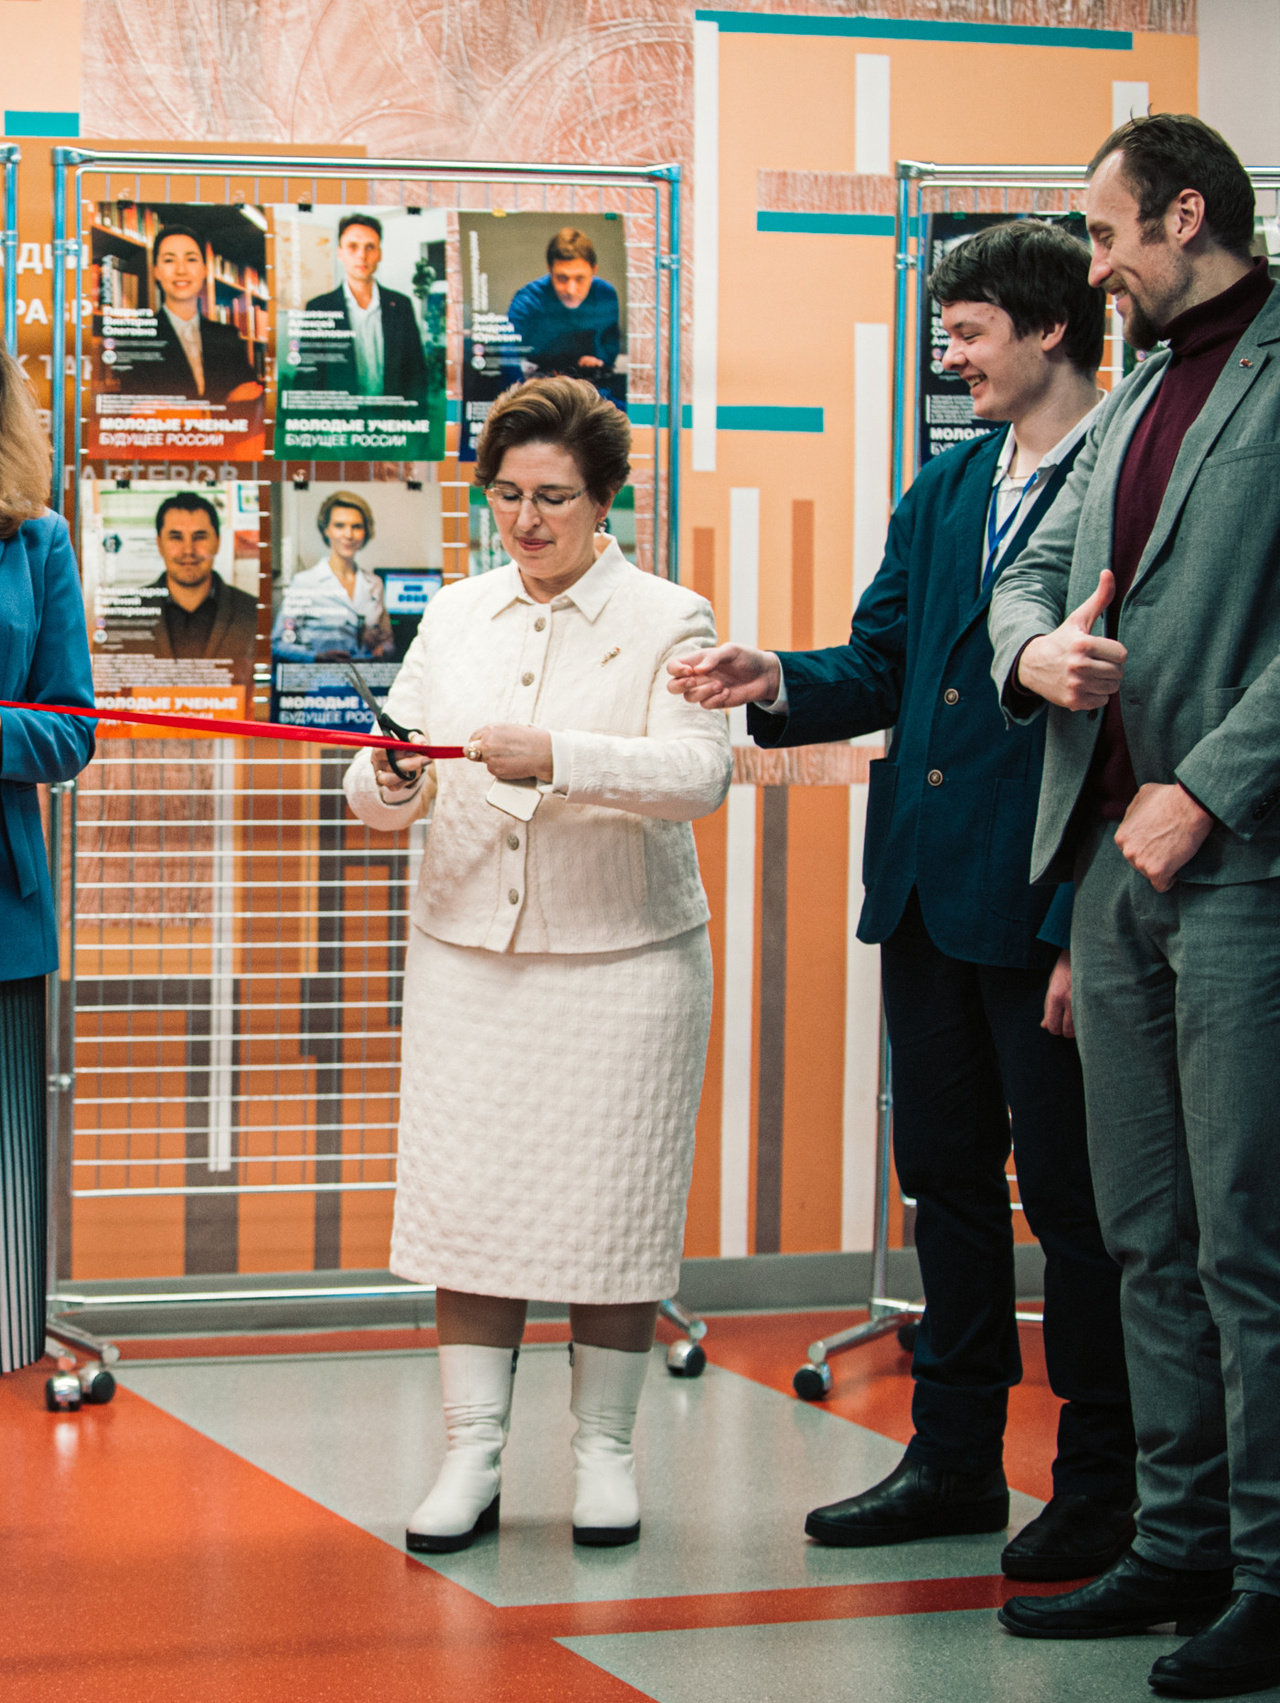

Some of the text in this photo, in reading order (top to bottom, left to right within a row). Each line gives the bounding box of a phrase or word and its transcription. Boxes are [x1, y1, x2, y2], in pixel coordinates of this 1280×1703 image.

[99, 418, 248, 432] МОЛОДЫЕ УЧЕНЫЕ
[285, 419, 430, 433] МОЛОДЫЕ УЧЕНЫЕ
[99, 433, 224, 448] БУДУЩЕЕ РОССИИ
[285, 433, 407, 448] БУДУЩЕЕ РОССИИ
[94, 697, 238, 710] МОЛОДЫЕ УЧЕНЫЕ
[280, 696, 359, 710] МОЛОДЫЕ
[279, 710, 342, 725] БУДУЩЕЕ
